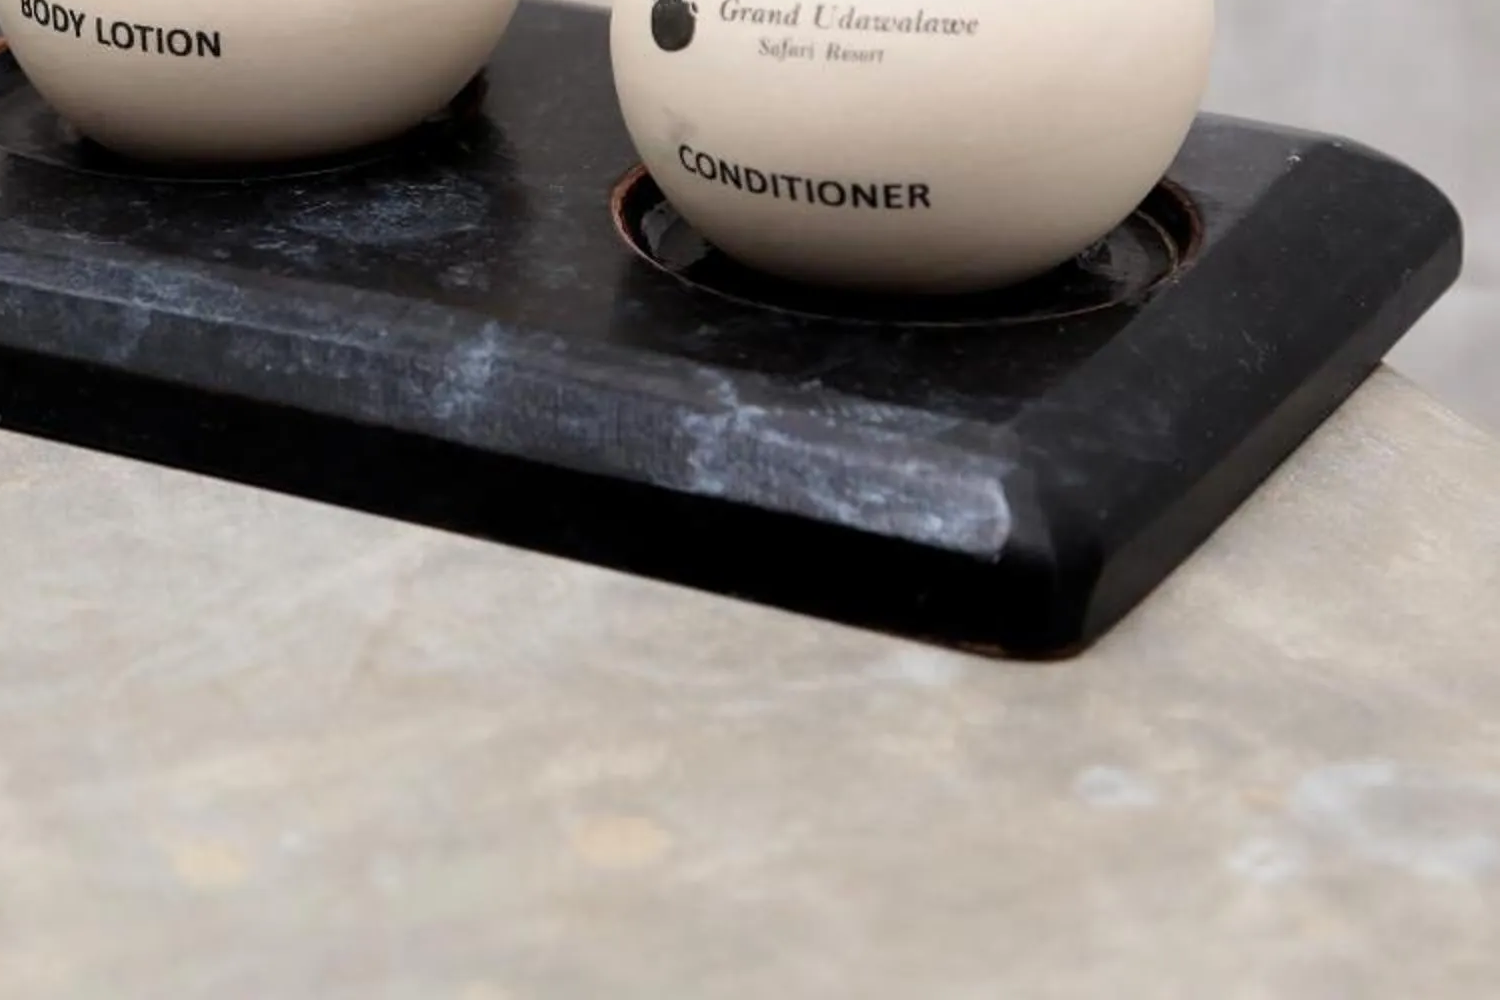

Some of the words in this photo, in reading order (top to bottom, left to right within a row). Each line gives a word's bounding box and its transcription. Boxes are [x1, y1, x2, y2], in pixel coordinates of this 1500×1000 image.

[95, 16, 222, 58] LOTION
[812, 3, 980, 37] Udawalawe
[757, 37, 816, 63] Safari
[825, 42, 886, 65] Resort
[677, 143, 932, 210] CONDITIONER
